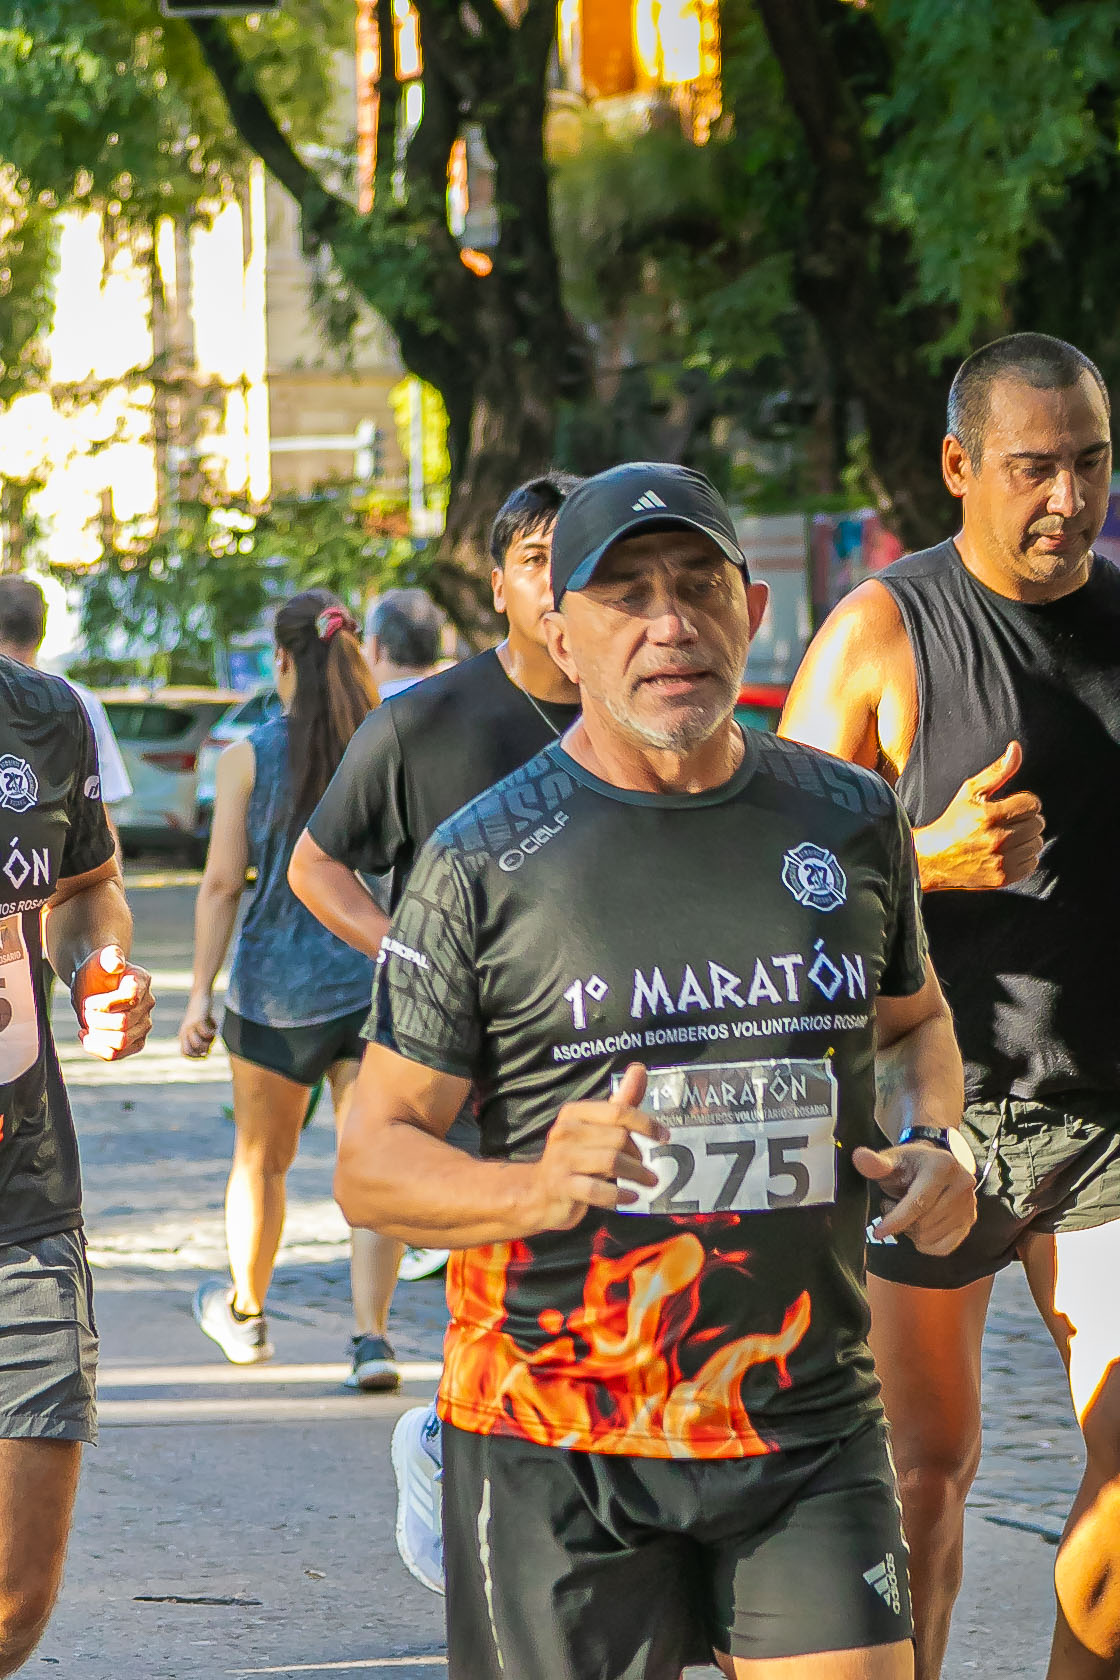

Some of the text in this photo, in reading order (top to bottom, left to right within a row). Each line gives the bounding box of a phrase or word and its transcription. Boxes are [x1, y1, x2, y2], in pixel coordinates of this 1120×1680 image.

[630, 937, 867, 1019] MARATÓN
[552, 1031, 642, 1062] ASOCIACIÓN
[645, 1023, 730, 1047] BOMBEROS
[732, 1014, 832, 1038] VOLUNTARIOS
[682, 1068, 808, 1110] MARATÓN
[649, 1135, 810, 1213] 275
[885, 1552, 900, 1615] adidas
